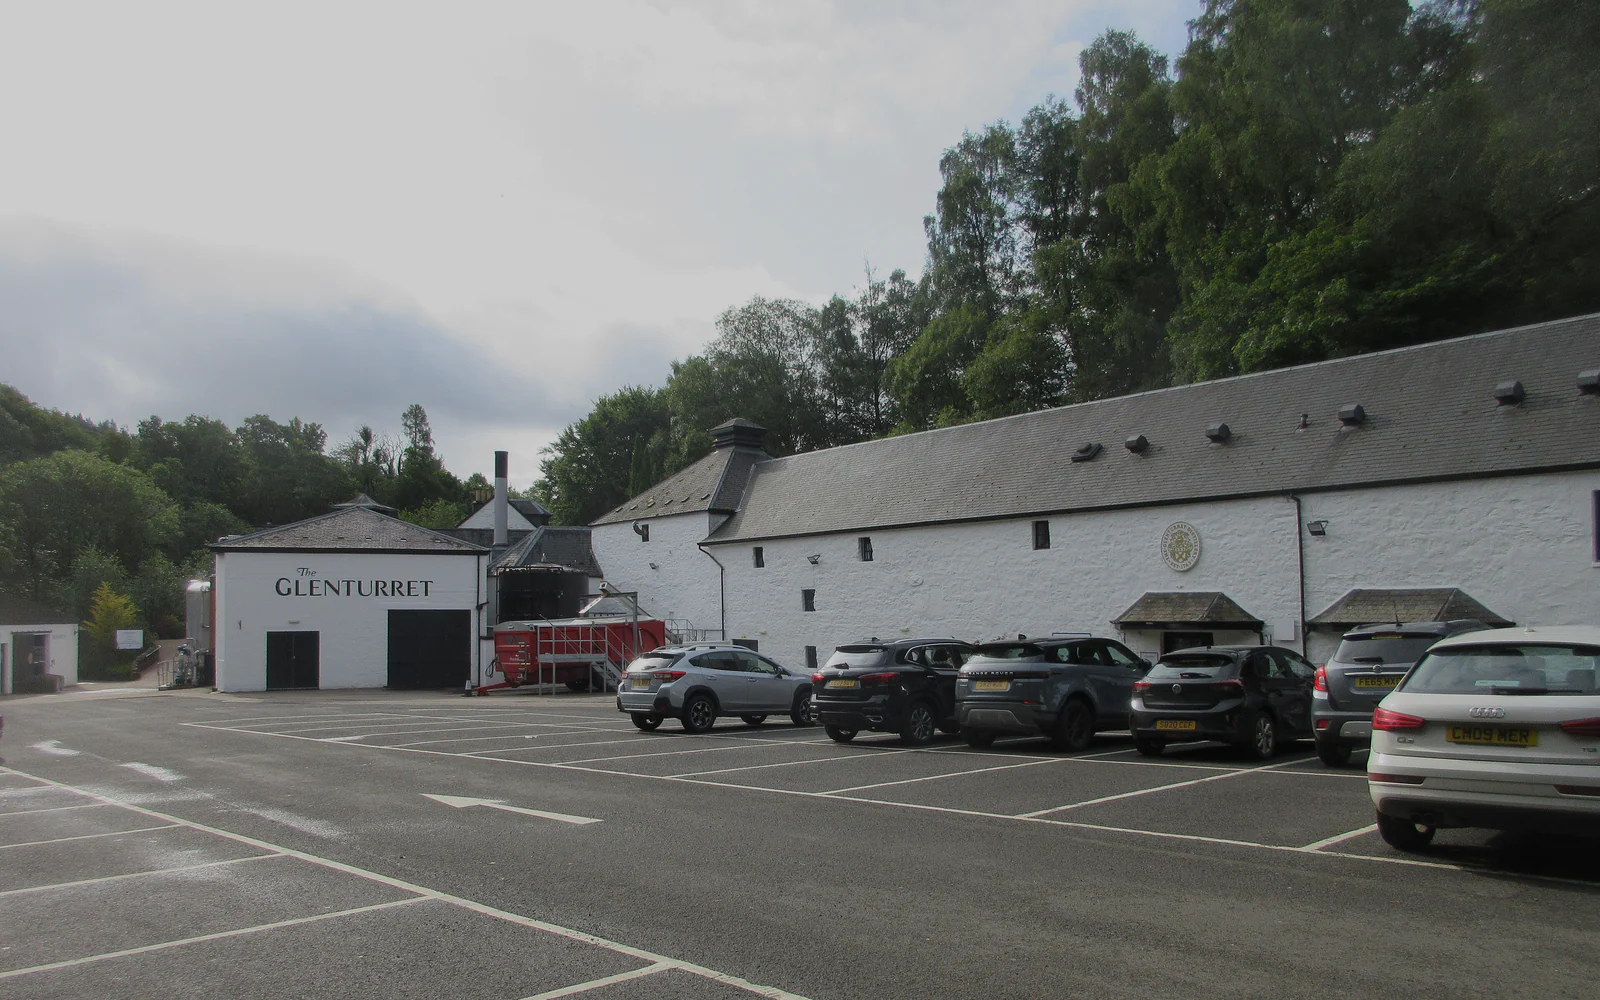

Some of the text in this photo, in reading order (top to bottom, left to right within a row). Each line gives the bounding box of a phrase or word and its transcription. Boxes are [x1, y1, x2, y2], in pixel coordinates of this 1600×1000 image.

[296, 567, 317, 577] The
[275, 577, 434, 597] GLENTURRET
[1358, 677, 1382, 686] FE65
[1497, 728, 1529, 743] MER
